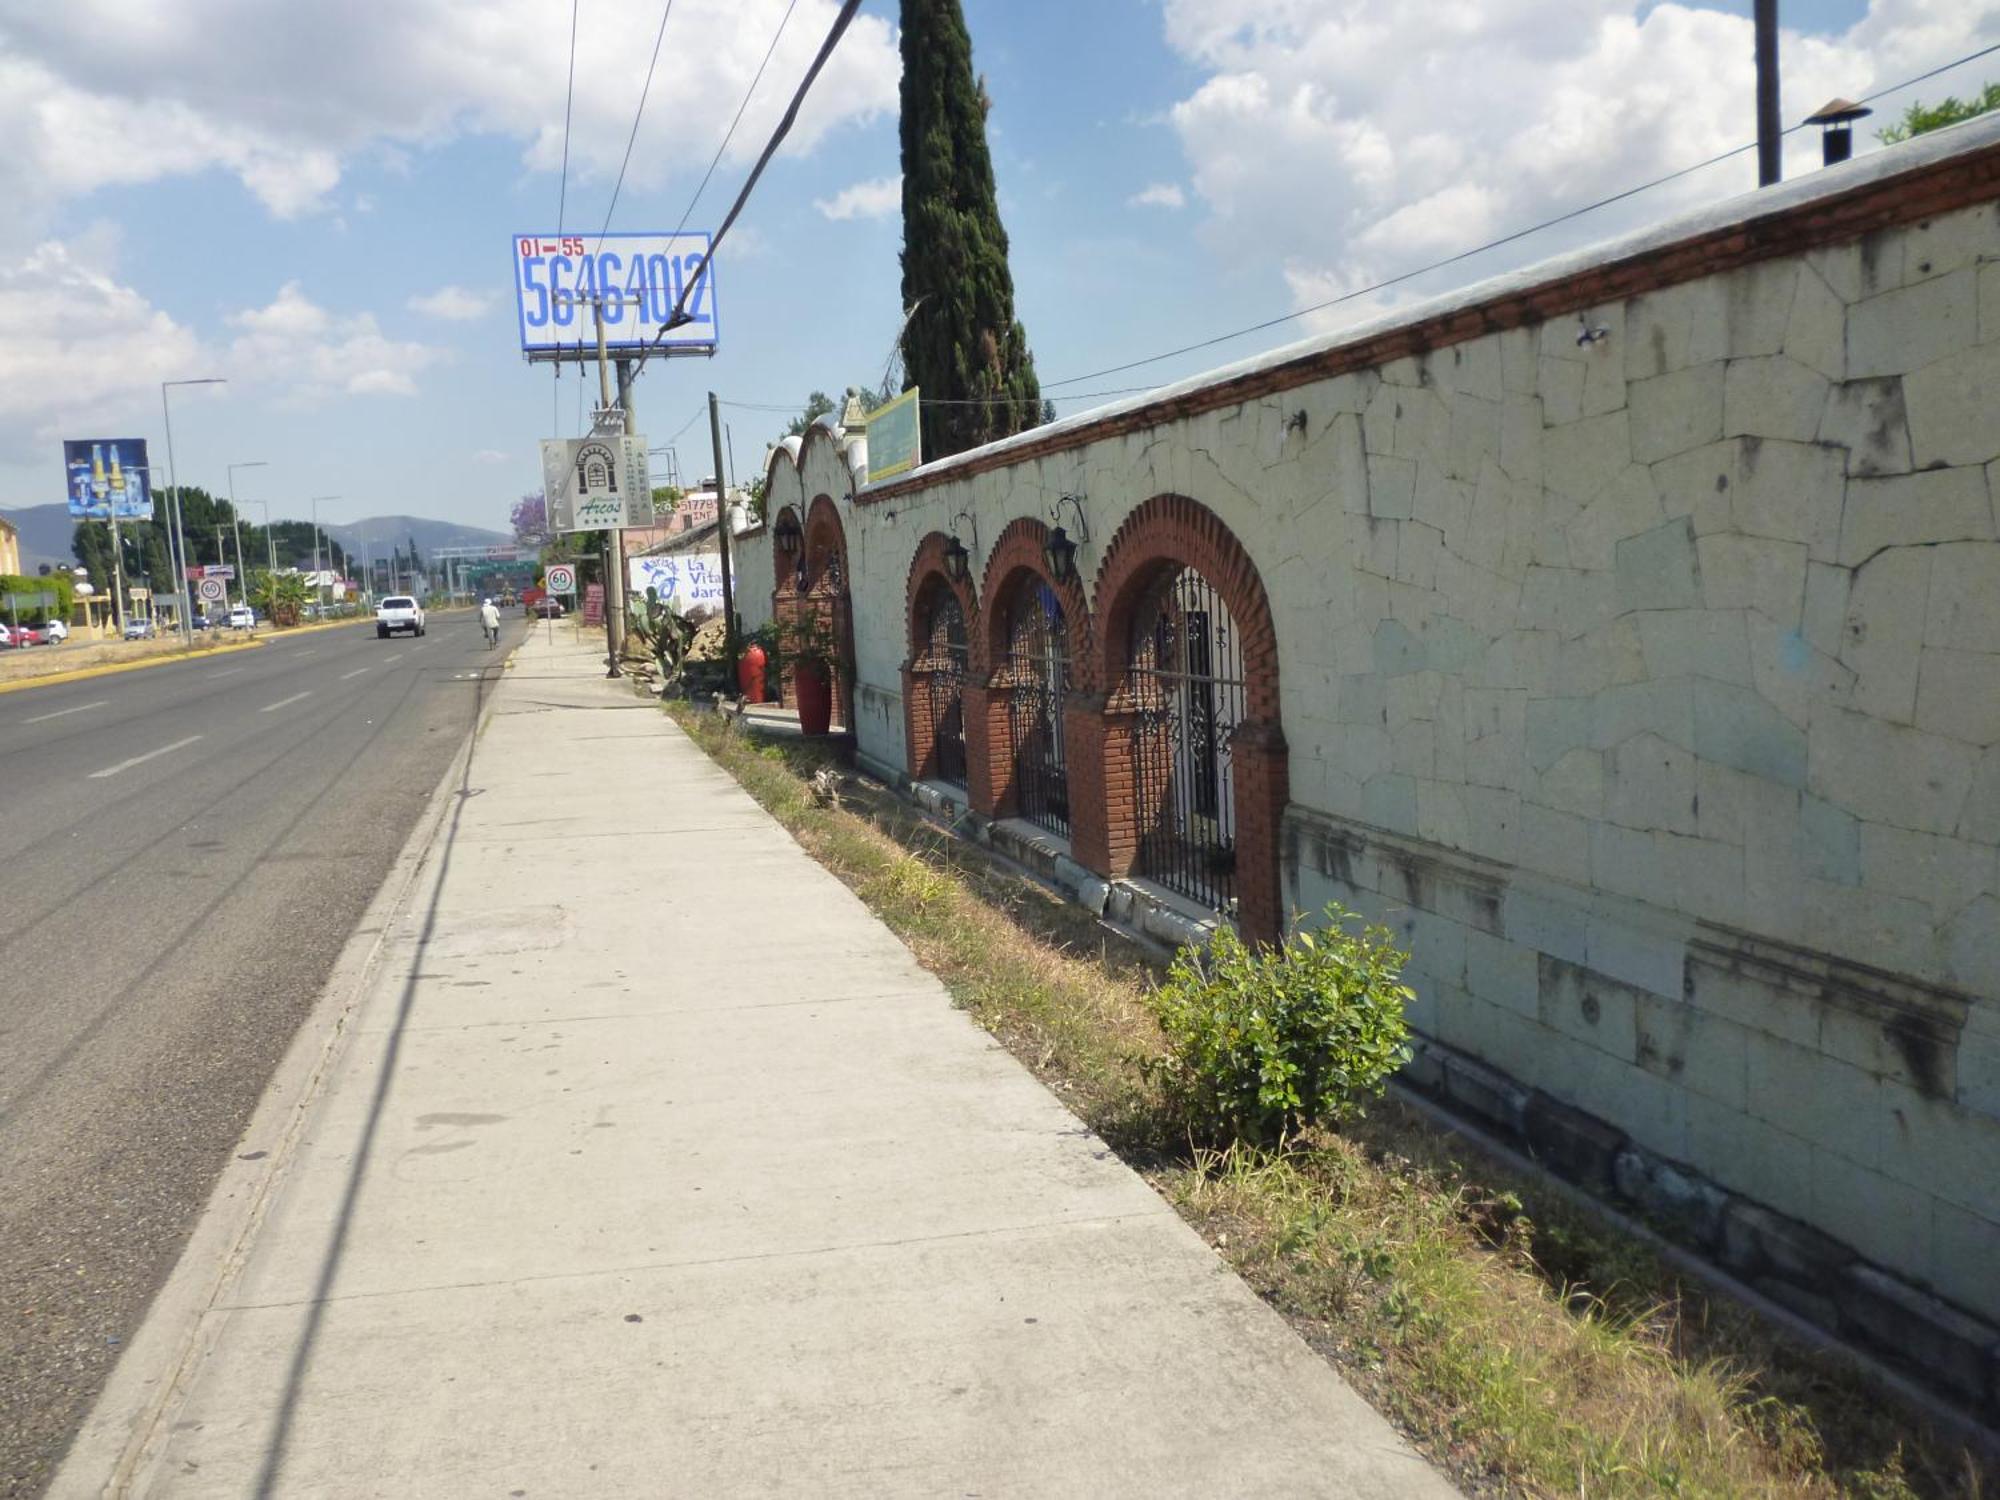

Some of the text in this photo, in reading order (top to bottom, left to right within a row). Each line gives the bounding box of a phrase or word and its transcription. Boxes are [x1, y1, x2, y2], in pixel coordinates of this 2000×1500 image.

[522, 252, 711, 328] 56464012
[576, 498, 620, 516] Arcos
[688, 558, 704, 571] La
[552, 572, 567, 584] 60
